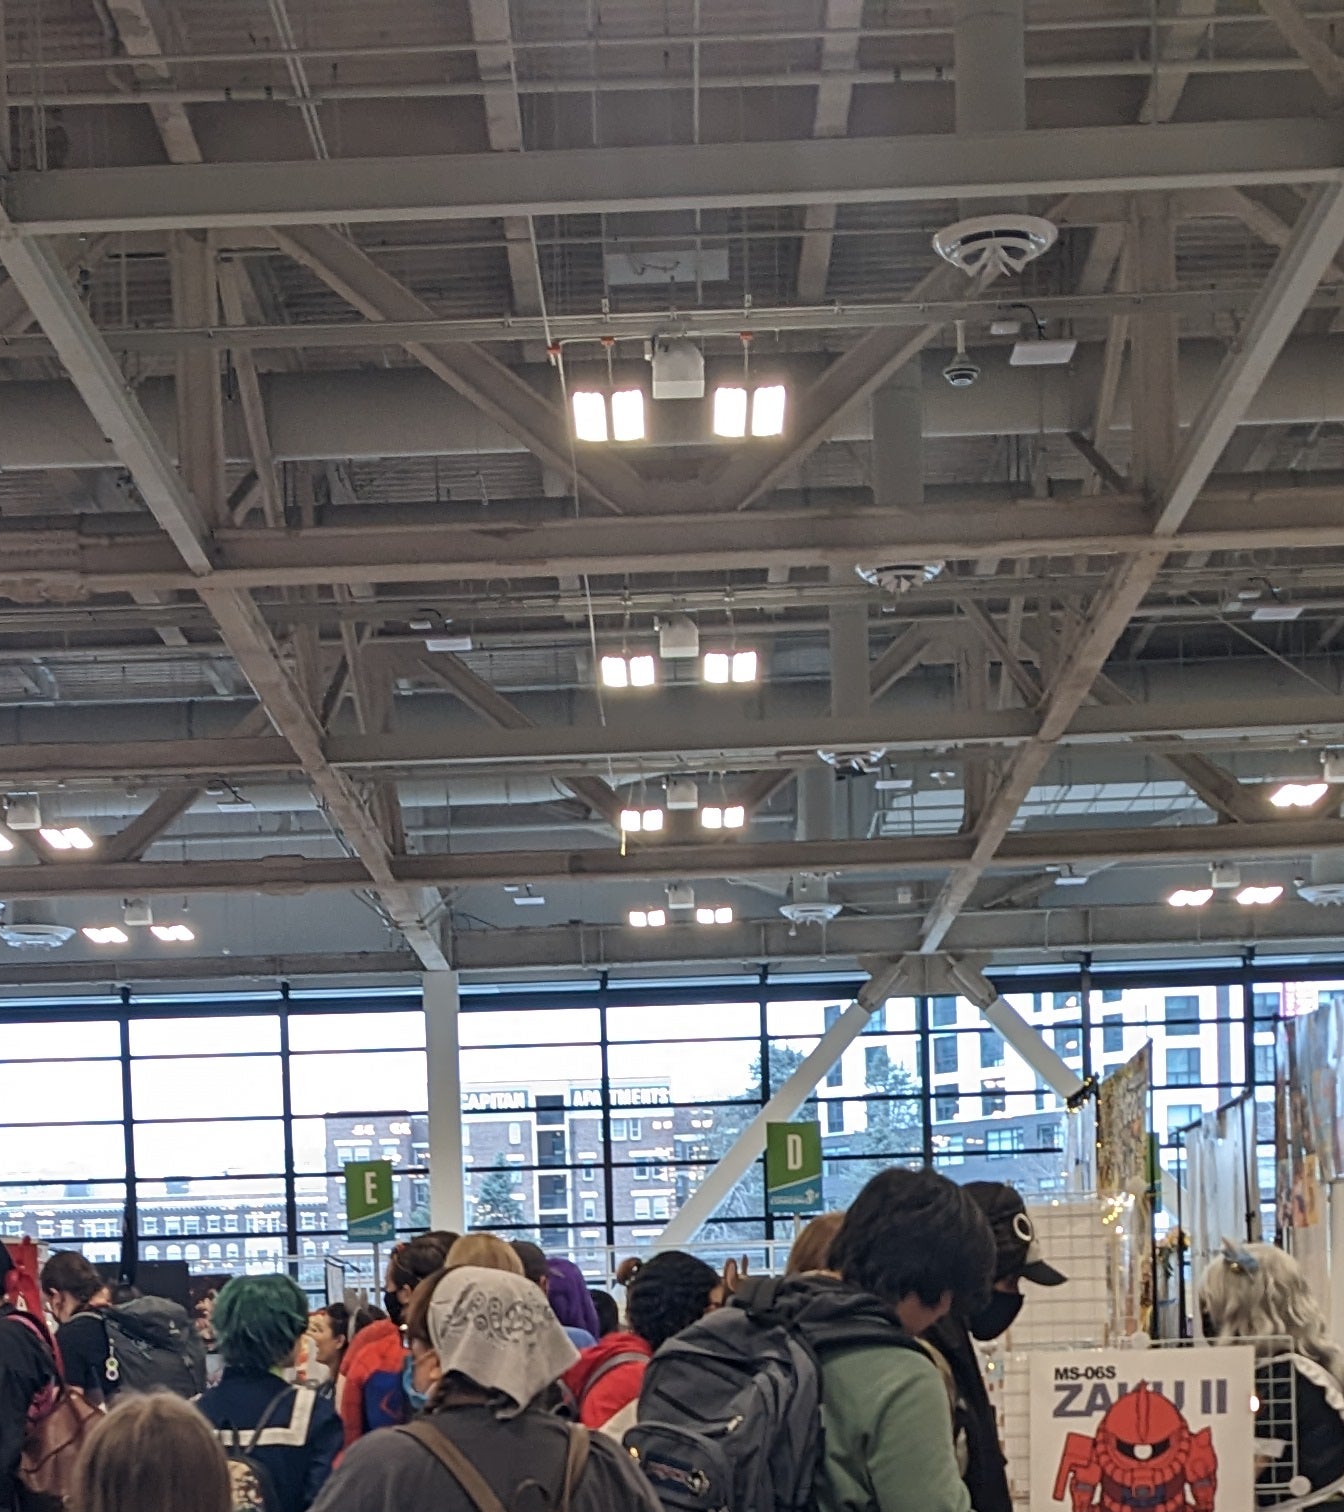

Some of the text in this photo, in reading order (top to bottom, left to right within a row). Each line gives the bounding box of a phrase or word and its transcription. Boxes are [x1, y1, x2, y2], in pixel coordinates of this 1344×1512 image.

[573, 1087, 670, 1107] APATMENTS
[787, 1134, 803, 1170] D
[364, 1171, 378, 1204] E
[1054, 1366, 1116, 1380] MS-06S
[1053, 1379, 1227, 1418] ZAU II
